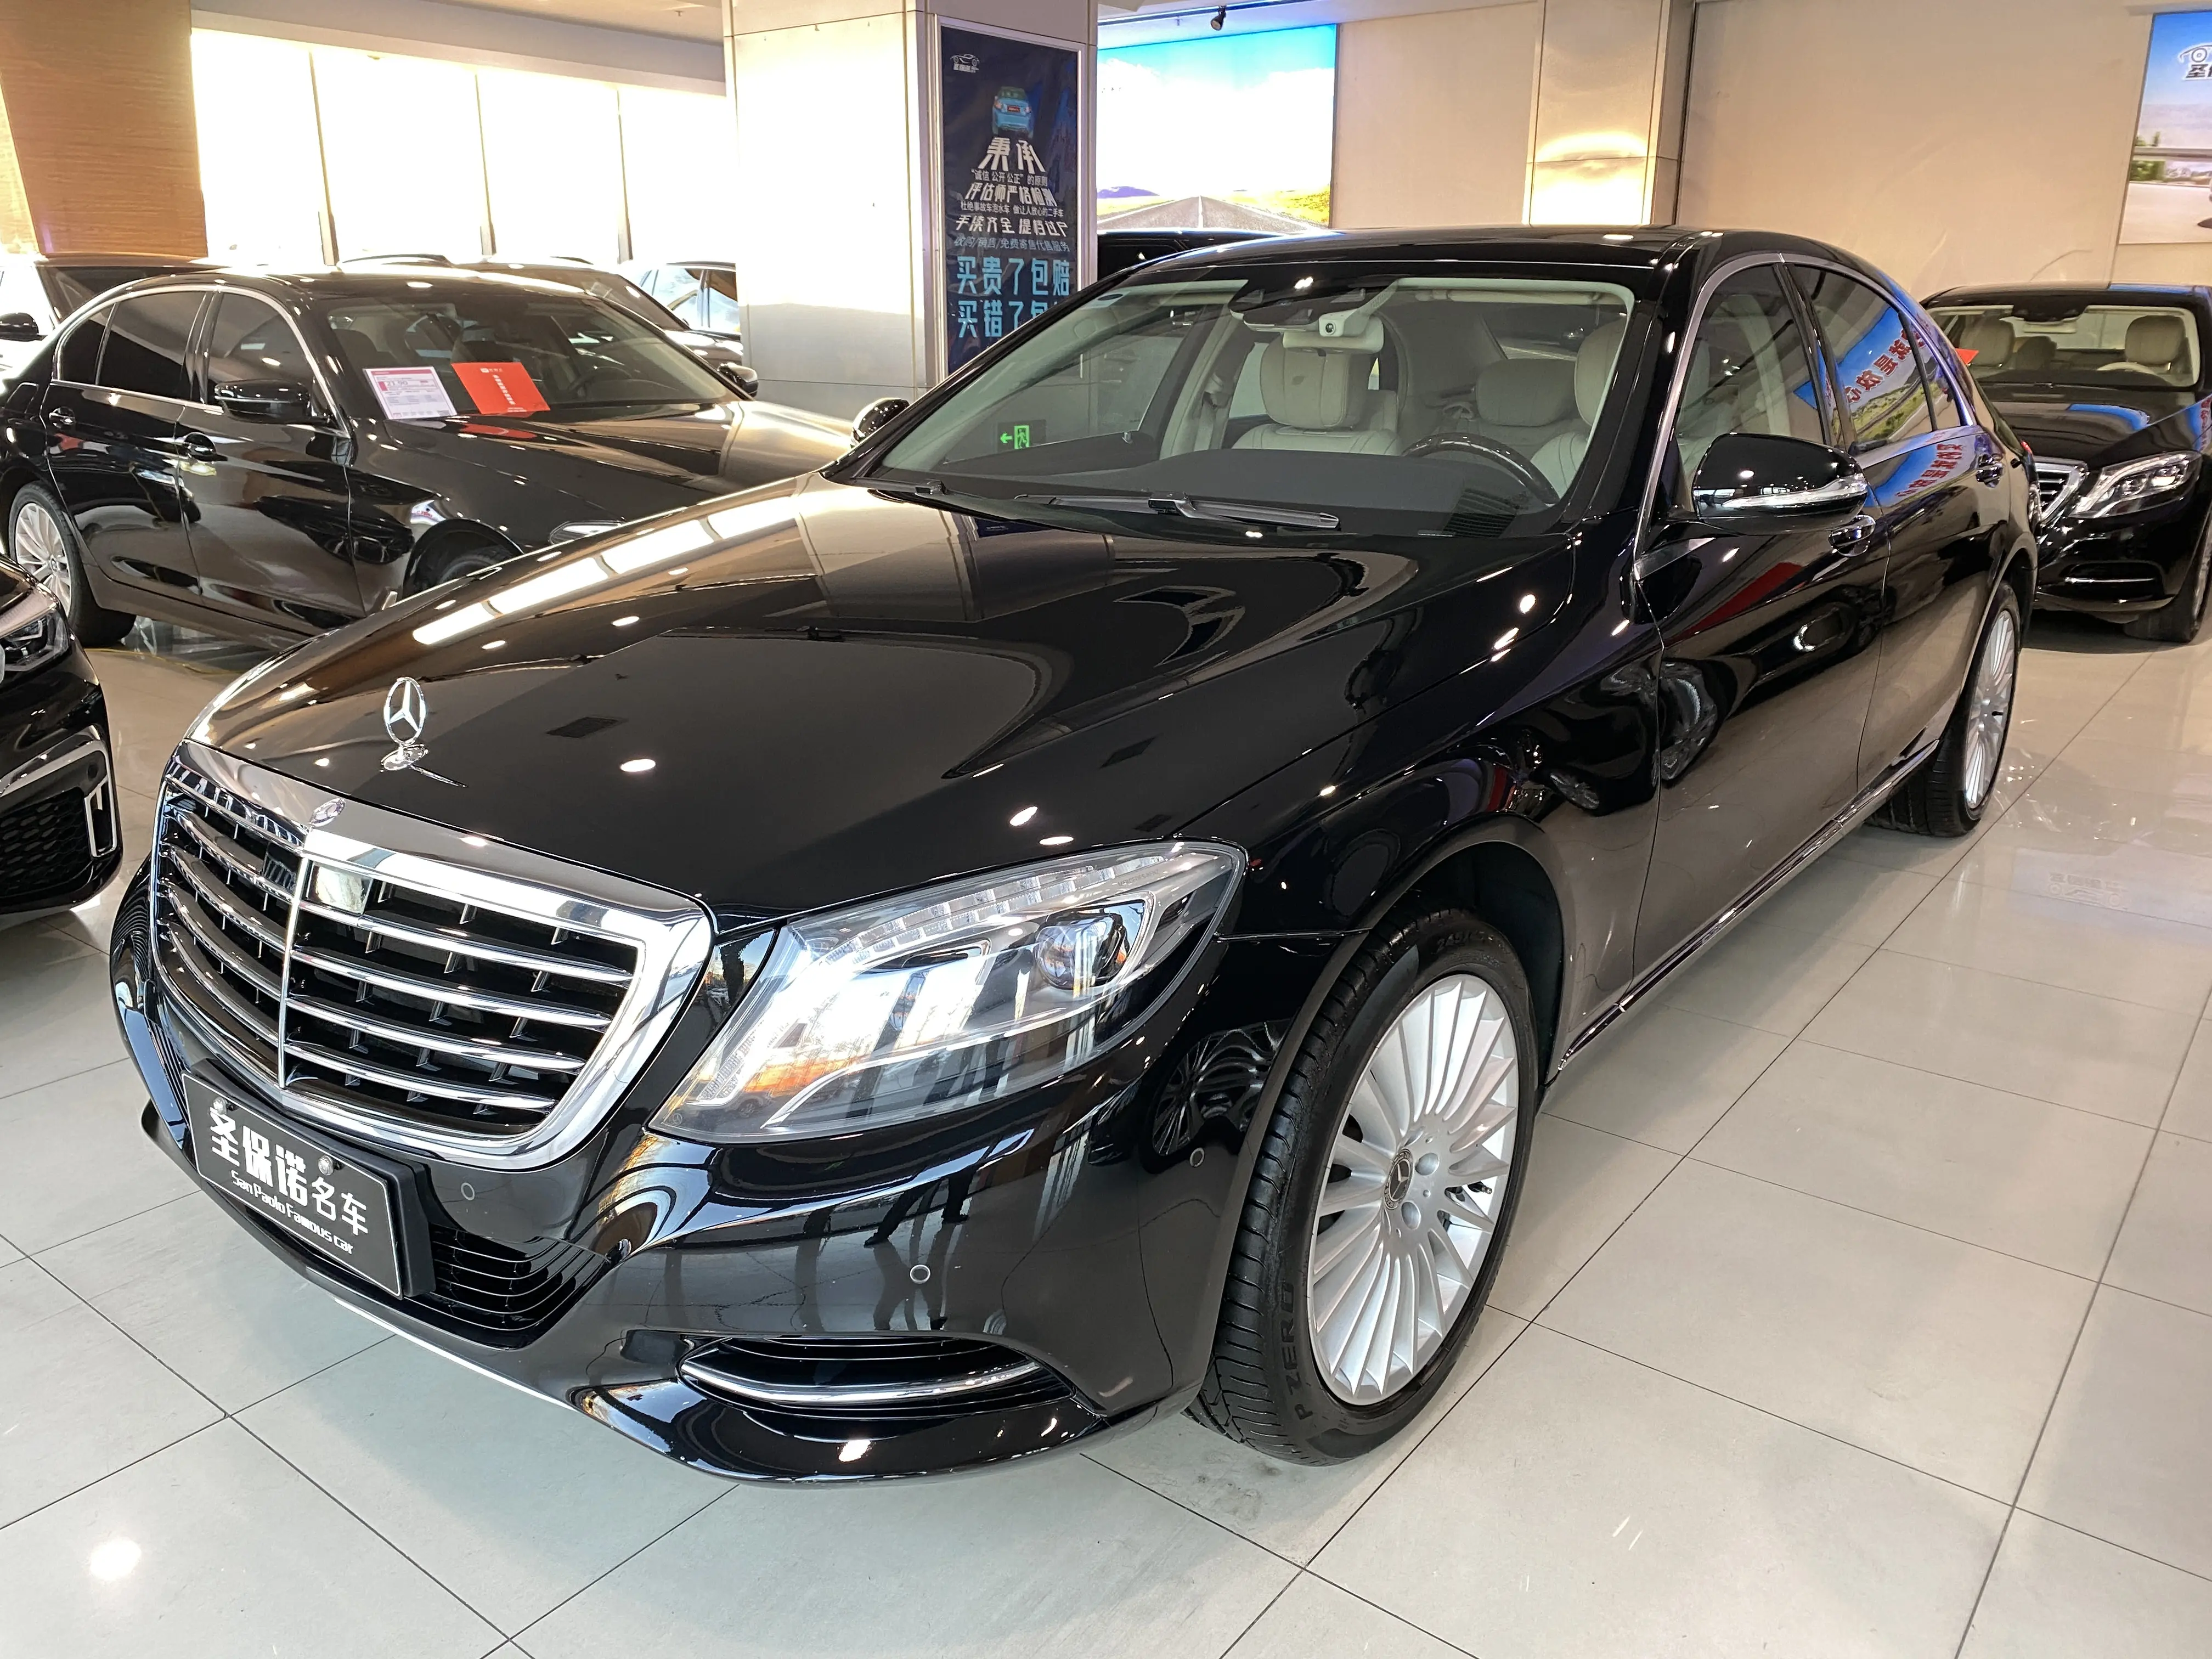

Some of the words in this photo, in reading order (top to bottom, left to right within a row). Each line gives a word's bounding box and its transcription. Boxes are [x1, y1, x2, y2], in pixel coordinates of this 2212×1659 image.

[2186, 64, 2212, 78] 圣
[978, 137, 1045, 174] 秉承
[964, 182, 1058, 207] 评估师严格检测
[991, 171, 1005, 183] 公开
[1027, 174, 1048, 187] 的原则
[956, 215, 1015, 234] 手续齐全
[1019, 218, 1068, 237] 提档过户
[957, 256, 1070, 296] 买贵了包赔
[958, 300, 1058, 338] 买错了
[210, 1107, 368, 1236] 圣保诺名车
[231, 1170, 253, 1195] San
[253, 1183, 286, 1214] Paolo
[286, 1203, 332, 1243] Famous
[1280, 1282, 1302, 1396] ZERO
